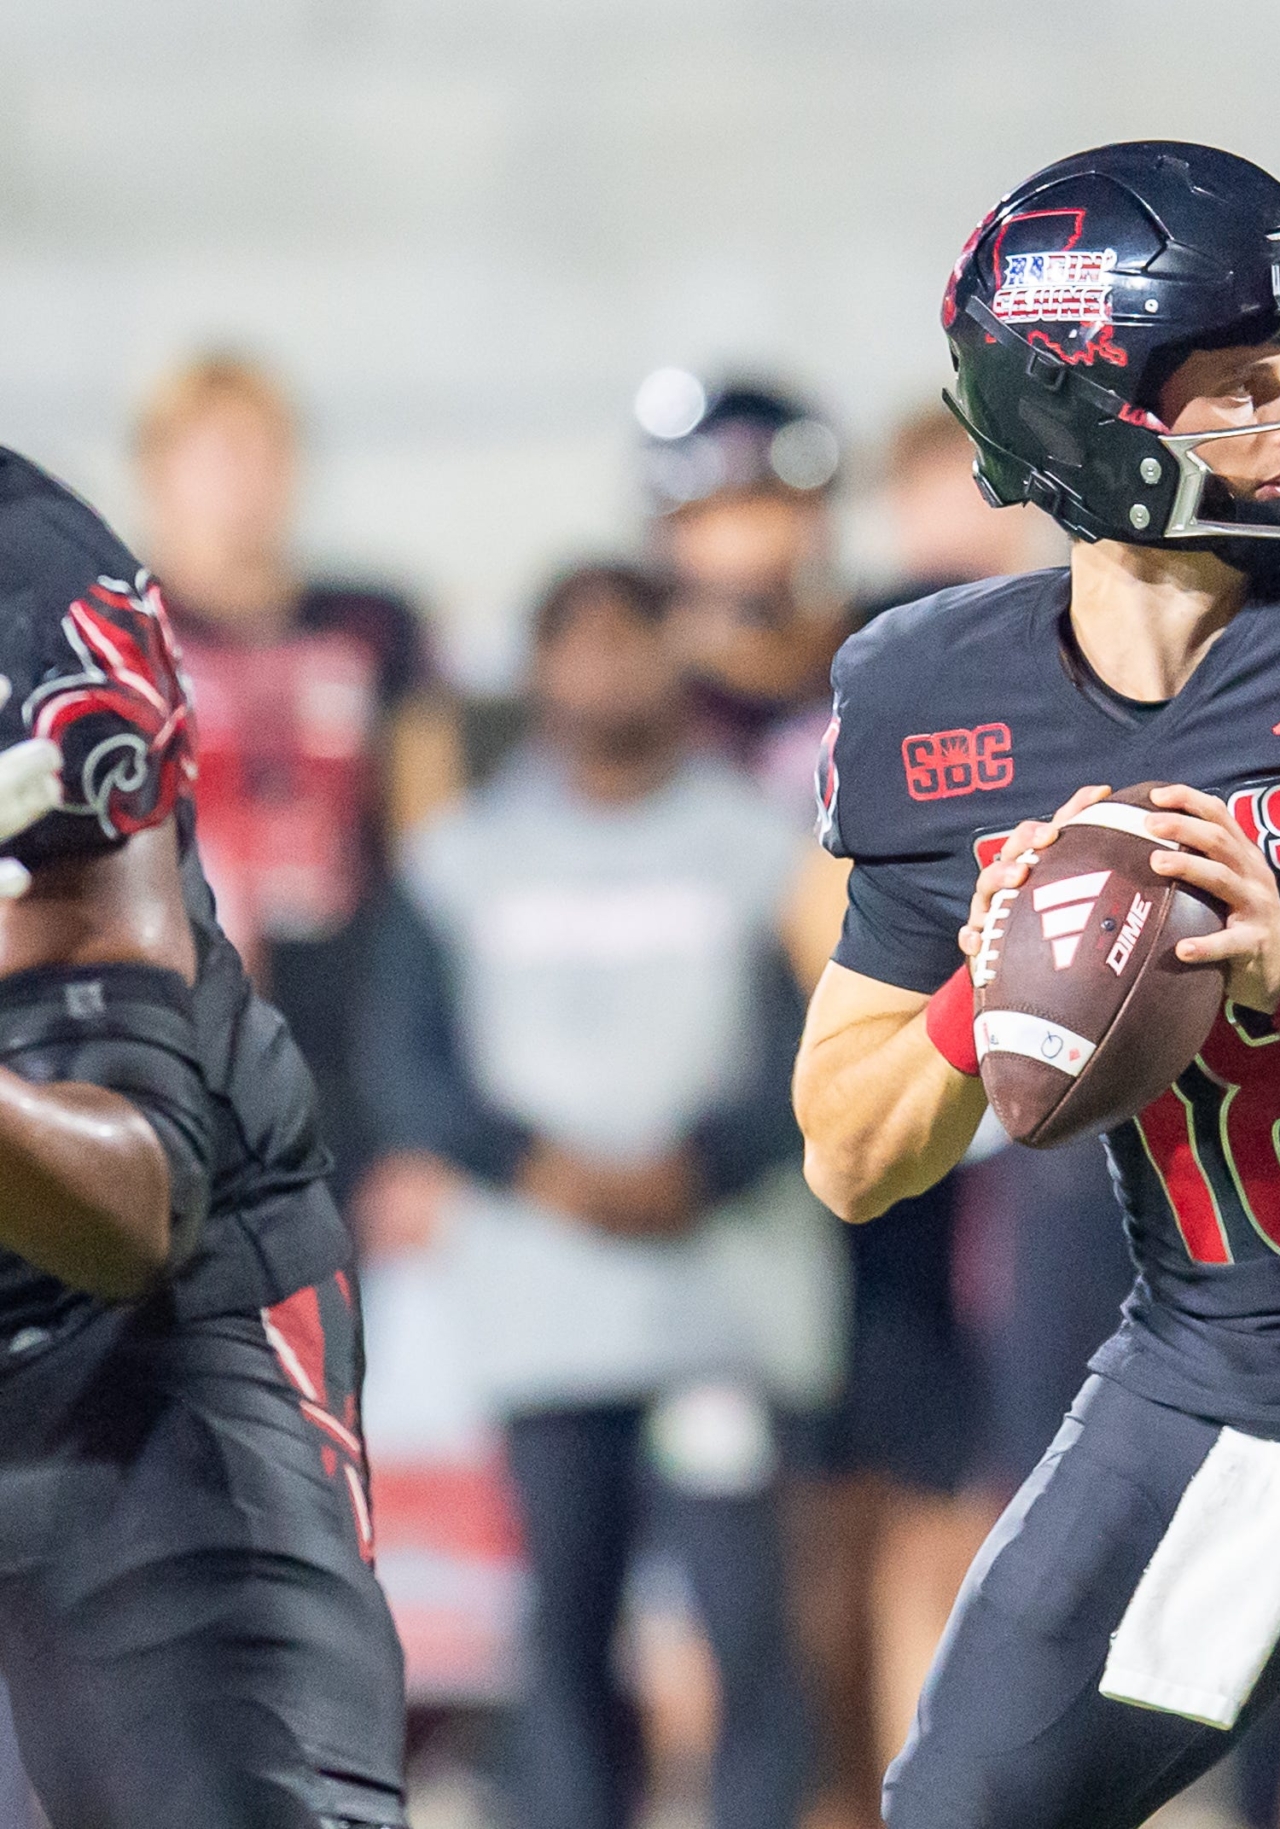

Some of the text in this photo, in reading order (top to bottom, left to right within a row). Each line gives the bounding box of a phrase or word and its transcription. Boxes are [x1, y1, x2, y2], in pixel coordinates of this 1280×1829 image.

[993, 285, 1112, 323] CAJUNS
[902, 722, 1014, 801] SBC
[1105, 891, 1152, 976] DIME
